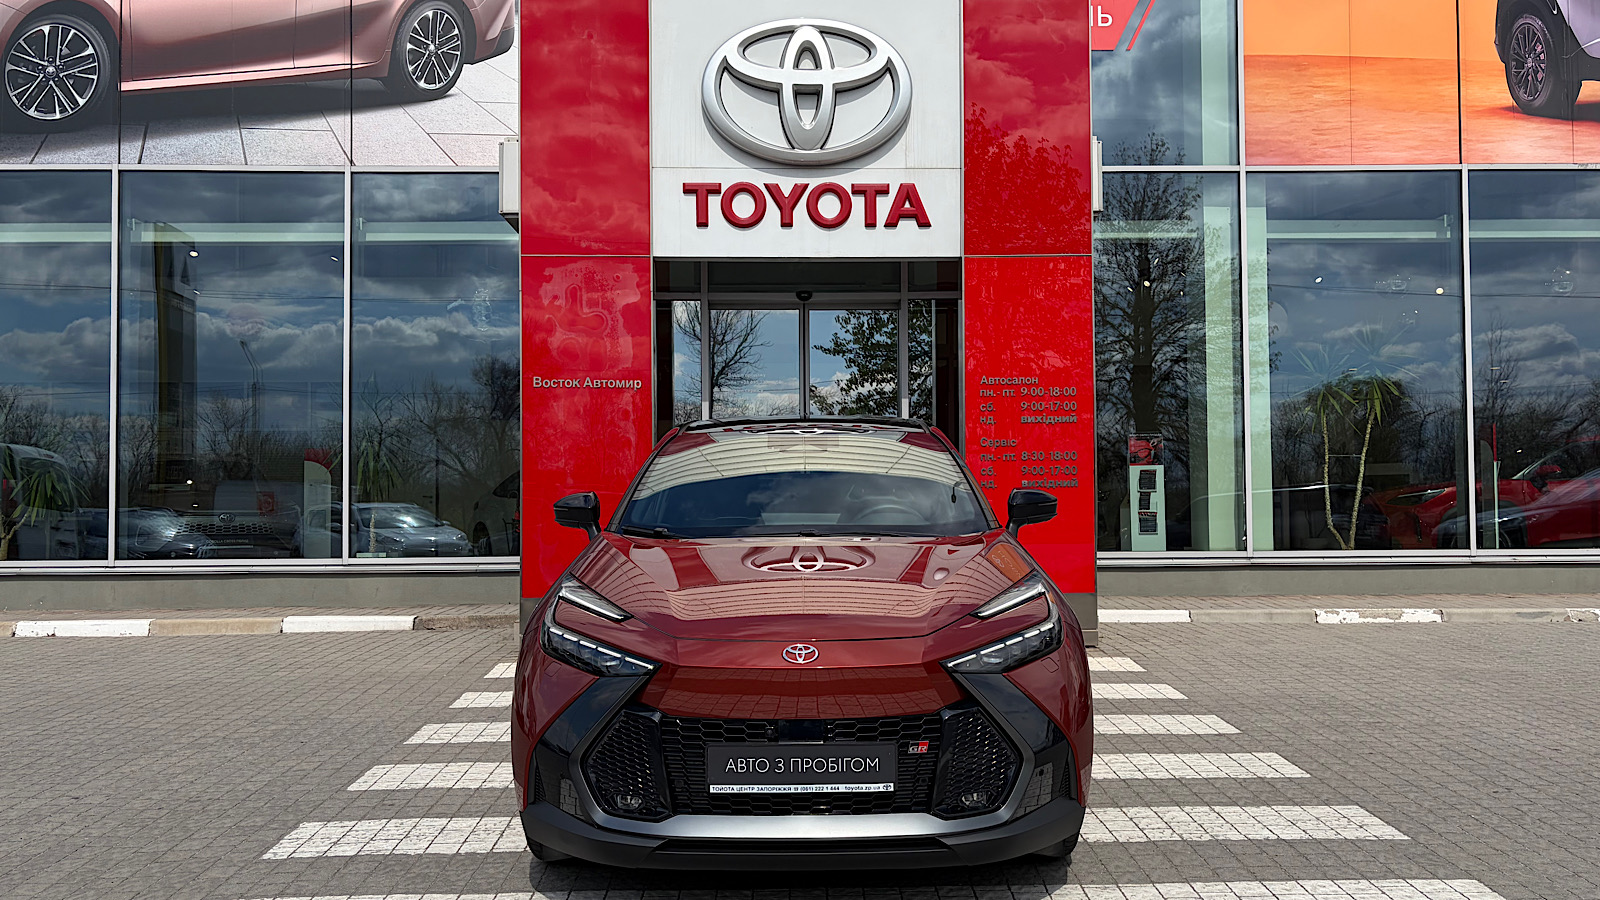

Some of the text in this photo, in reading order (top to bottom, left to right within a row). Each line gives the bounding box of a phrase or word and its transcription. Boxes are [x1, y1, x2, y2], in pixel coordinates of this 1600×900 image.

[682, 181, 932, 229] TOYOTA
[532, 376, 642, 391] Восток Автомир
[980, 375, 1039, 385] Автосалон
[980, 401, 1078, 412] сб. 9:00-17:00
[980, 413, 1078, 425] нд. вихідний
[980, 437, 1017, 449] Сервіс
[1021, 451, 1078, 461] 8:30-18:00
[980, 465, 1078, 476] сб. 9:00-17:00
[980, 477, 1079, 489] нд. вихідний
[909, 744, 928, 753] GR
[725, 758, 770, 773] АВТО
[790, 757, 880, 773] ПРОБІГОМ
